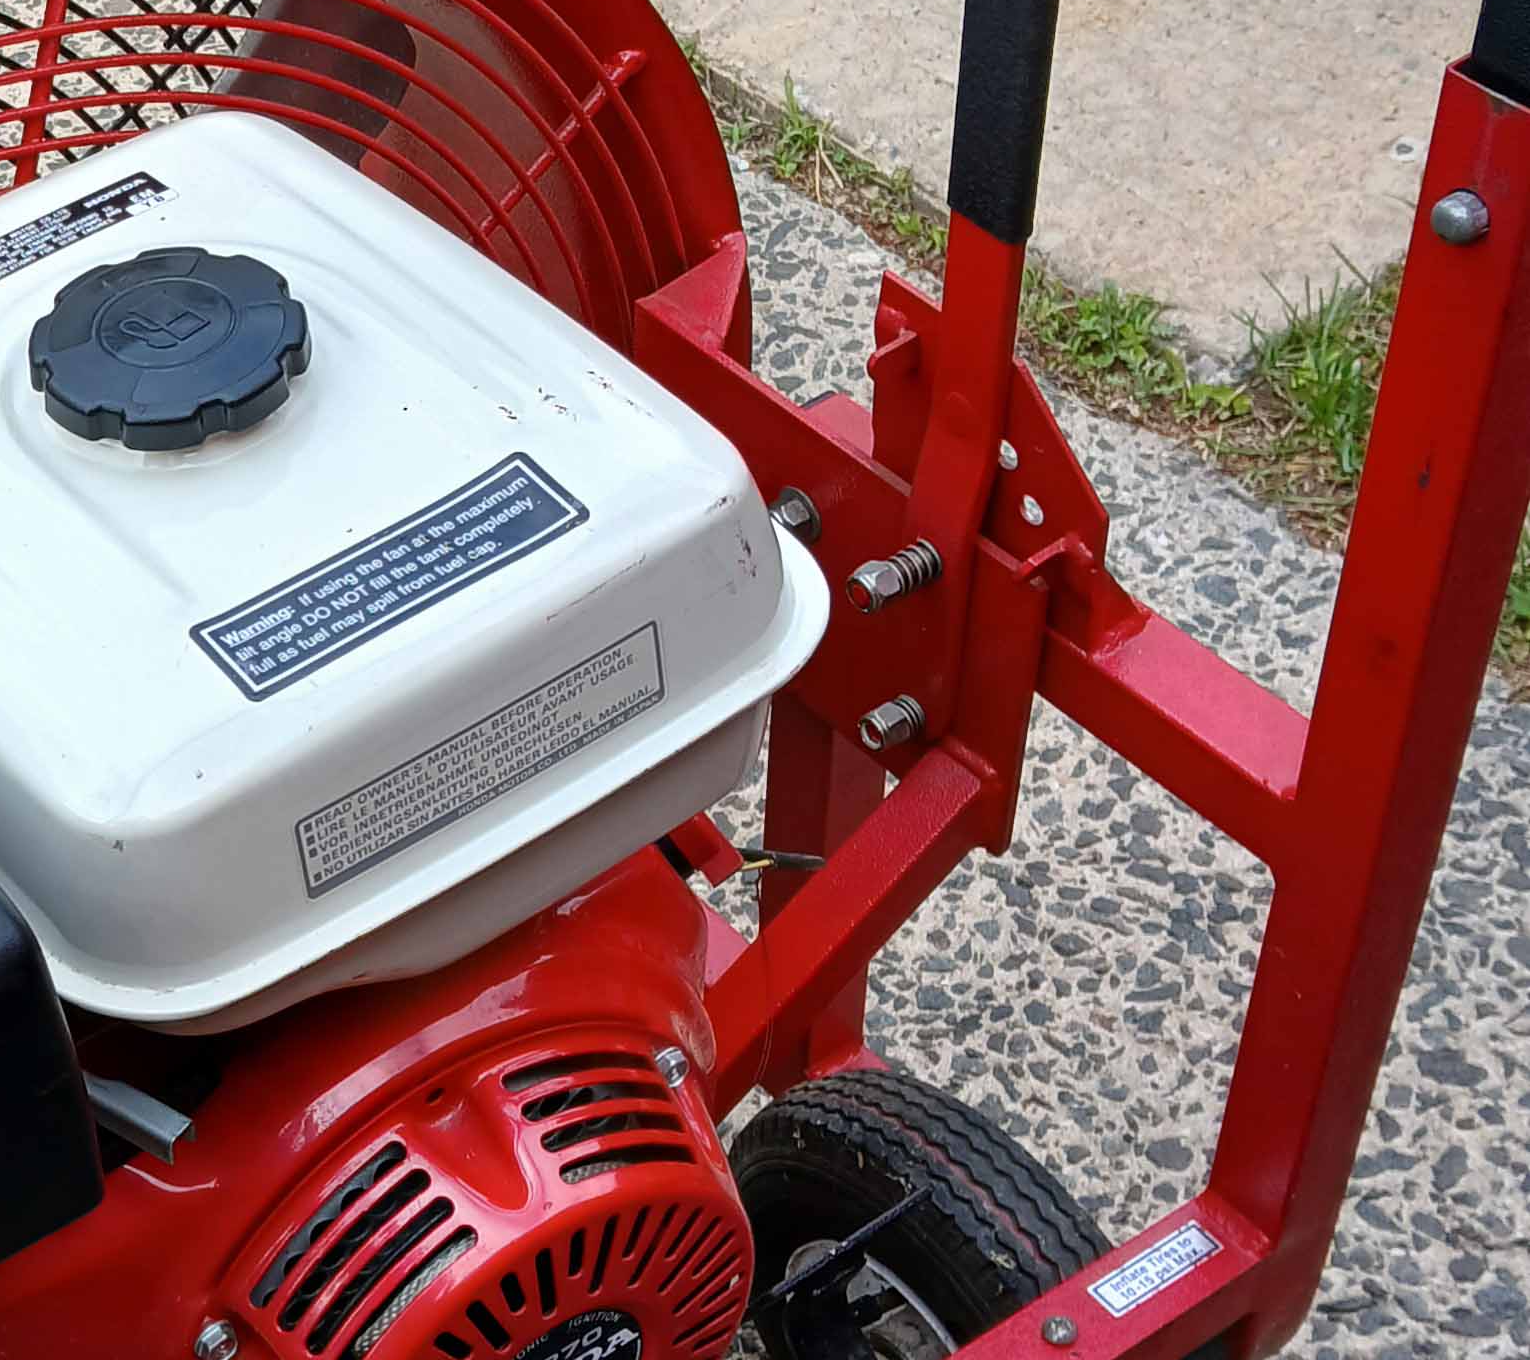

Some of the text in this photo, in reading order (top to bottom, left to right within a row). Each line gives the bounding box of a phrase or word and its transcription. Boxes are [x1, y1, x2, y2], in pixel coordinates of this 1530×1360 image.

[221, 606, 295, 647] Warning:
[313, 573, 359, 599] using
[355, 559, 383, 575] the
[382, 544, 411, 562] fan
[411, 534, 430, 548] at
[427, 521, 455, 538] the
[456, 477, 528, 524] maximum
[235, 646, 259, 662] tilt
[259, 623, 302, 651] angle
[301, 606, 331, 626] DO
[331, 584, 369, 610] NOT
[369, 574, 391, 590] fill
[390, 562, 418, 579] the
[417, 541, 454, 565] tank
[249, 541, 502, 676] full as fuel may spill from fuel cap.
[314, 801, 352, 828] READ
[357, 762, 423, 804] OWNER'S
[427, 728, 486, 766] MANUAL
[491, 694, 542, 730] BEFORE
[317, 817, 346, 841] LIRE
[352, 805, 367, 821] LE
[374, 771, 432, 809] MANUEL
[437, 711, 536, 773] D'UTILISATEUR
[541, 681, 584, 716] AVANT
[318, 710, 558, 852] VOR INBETRIEBNAHME UNBEDINGT
[322, 766, 488, 864] BEDIENUNGSANLEITUNG
[323, 860, 344, 877] NO
[346, 826, 404, 864] UTILIZAR
[407, 812, 429, 832] SIN
[432, 787, 474, 818] ANTES
[476, 775, 496, 793] NO
[498, 749, 541, 780] HABER
[543, 727, 580, 754] LEIDO
[582, 717, 596, 731] EL
[458, 791, 496, 816] HONDA
[498, 767, 535, 792] MOTOR
[583, 723, 611, 744] MADE
[613, 714, 625, 725] IN
[627, 695, 659, 719] JAPAN
[1110, 1238, 1192, 1292] Inflate Tires to
[1155, 1263, 1177, 1283] psi
